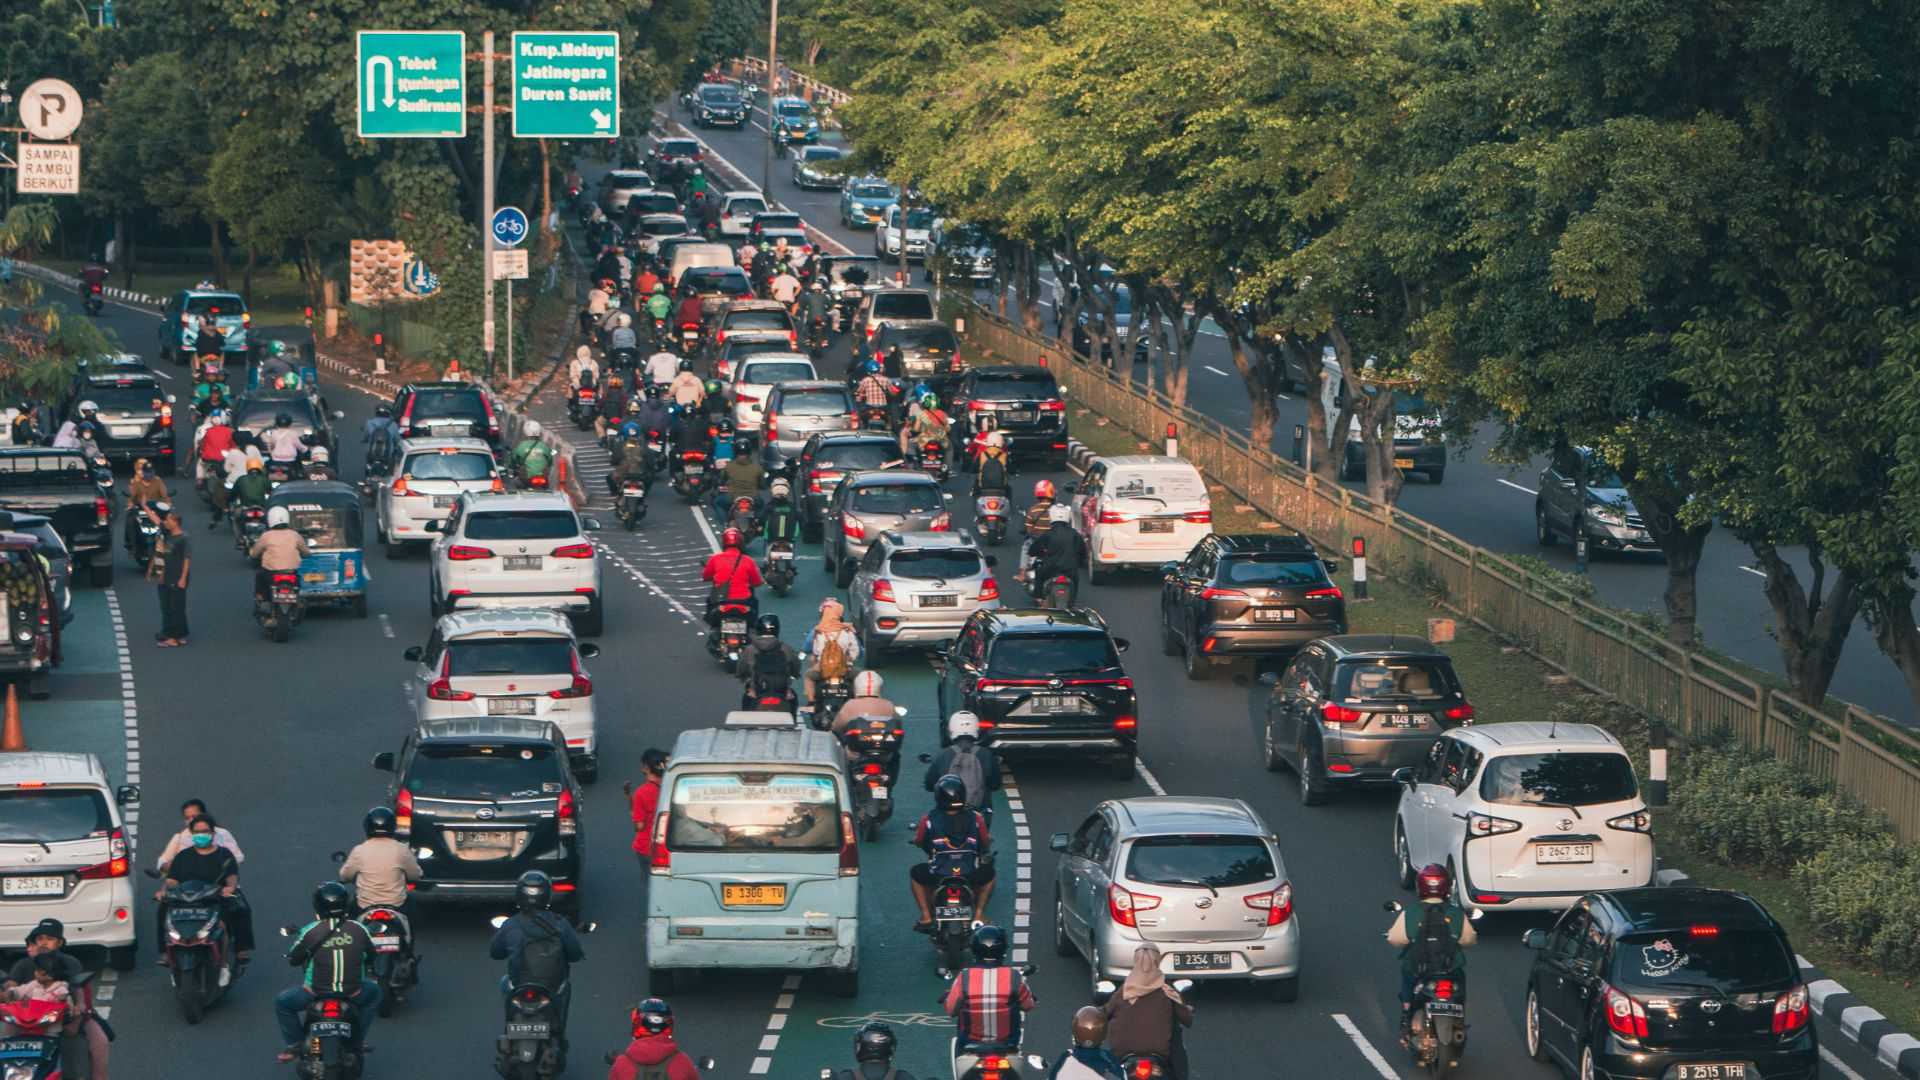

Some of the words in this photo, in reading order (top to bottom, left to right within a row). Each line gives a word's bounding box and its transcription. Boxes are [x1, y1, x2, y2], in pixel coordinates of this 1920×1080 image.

[520, 42, 615, 60] Kmp.Melayu
[398, 55, 437, 70] Tebet
[522, 65, 607, 82] Jatinegara
[398, 76, 460, 93] Kuningan
[521, 86, 565, 101] Duren
[568, 86, 613, 101] Sawit
[398, 98, 461, 112] Sudirman
[25, 148, 73, 160] SAMPAI
[25, 163, 73, 175] RAMBU
[23, 178, 75, 189] BERIKUT
[1538, 847, 1544, 857] B
[726, 887, 732, 898] B
[1680, 1065, 1687, 1079] B
[1693, 1065, 1719, 1079] 2515
[1725, 1065, 1743, 1078] TFH
